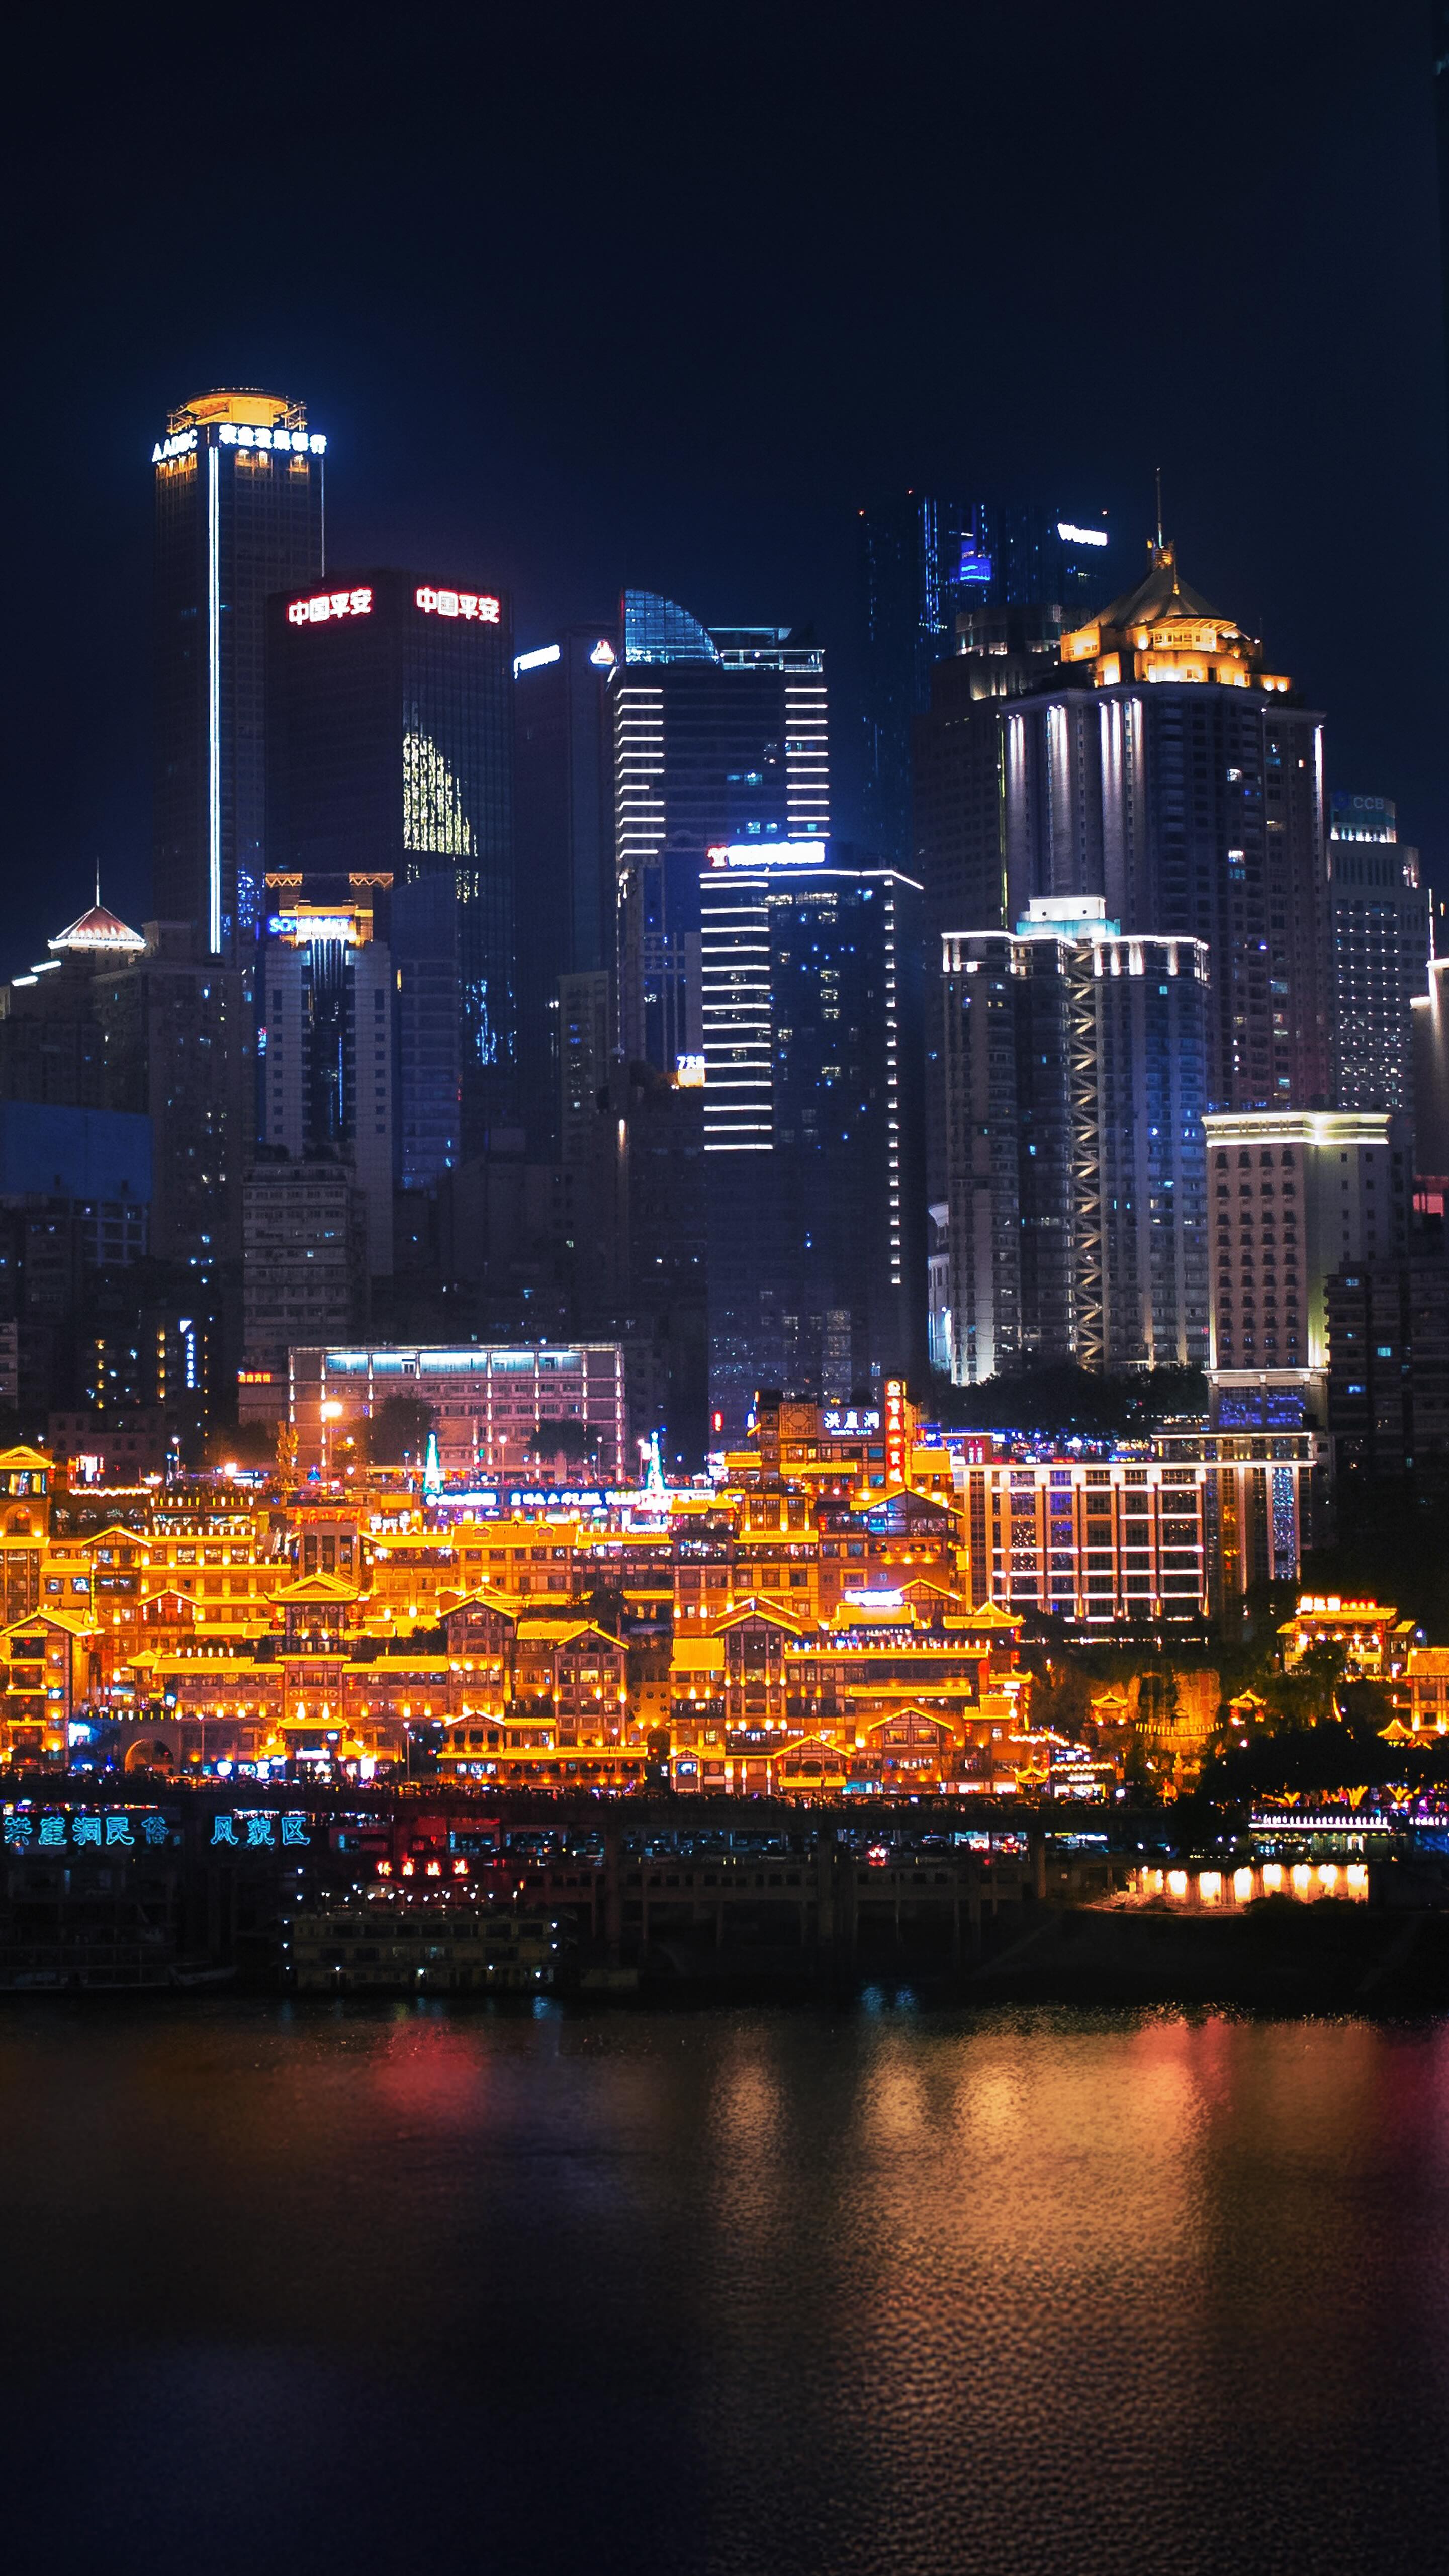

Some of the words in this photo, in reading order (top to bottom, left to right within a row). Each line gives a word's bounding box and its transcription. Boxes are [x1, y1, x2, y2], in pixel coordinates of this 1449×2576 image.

[288, 589, 372, 625] 中国平安
[416, 587, 500, 623] 中国平安
[1353, 797, 1385, 809] CCB
[823, 1411, 879, 1429] 洪崖洞
[4, 1816, 169, 1846] 洪崖洞民俗
[210, 1816, 311, 1845] 风貌区
